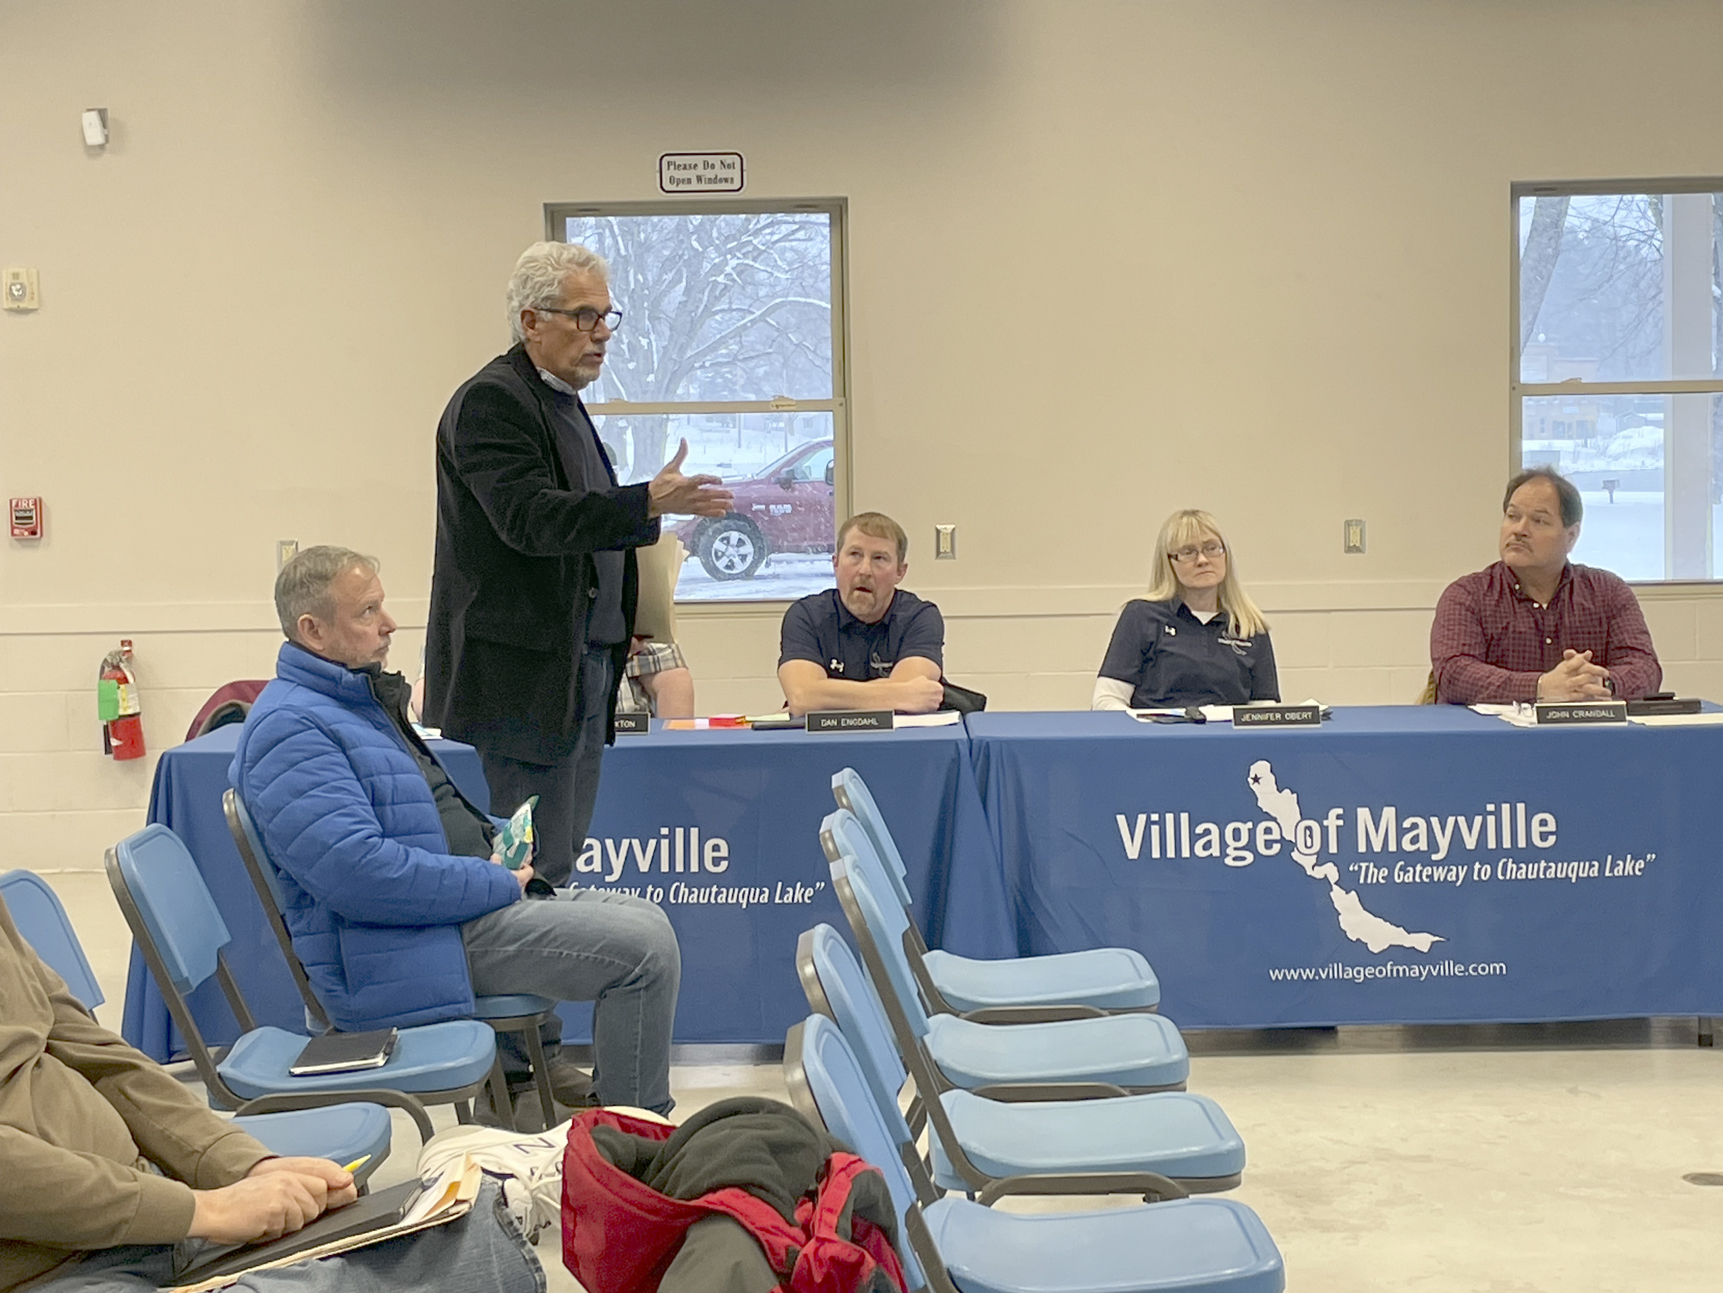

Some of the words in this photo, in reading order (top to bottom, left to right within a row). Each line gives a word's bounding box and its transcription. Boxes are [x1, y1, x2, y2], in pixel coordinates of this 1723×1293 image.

[667, 160, 698, 171] Please
[703, 160, 716, 171] Do
[720, 159, 736, 170] Not
[669, 175, 692, 187] Open
[696, 174, 734, 185] Windows
[12, 499, 35, 508] FIRE
[1241, 712, 1282, 722] JENNIFER
[1284, 711, 1313, 721] OBERT
[1546, 710, 1570, 719] JOHN
[1572, 709, 1616, 719] CRANDALL
[821, 718, 838, 727] DAN
[1116, 812, 1282, 867] Village
[1295, 808, 1344, 855] of
[1356, 802, 1558, 861] Mayville
[575, 827, 730, 883] ayville
[1394, 860, 1467, 885] Gateway
[1473, 861, 1492, 881] to
[1497, 857, 1599, 884] Chautauqua
[646, 884, 664, 904] to
[669, 881, 770, 909] Chautauqua
[1269, 960, 1507, 982] www.villageofmayville.com
